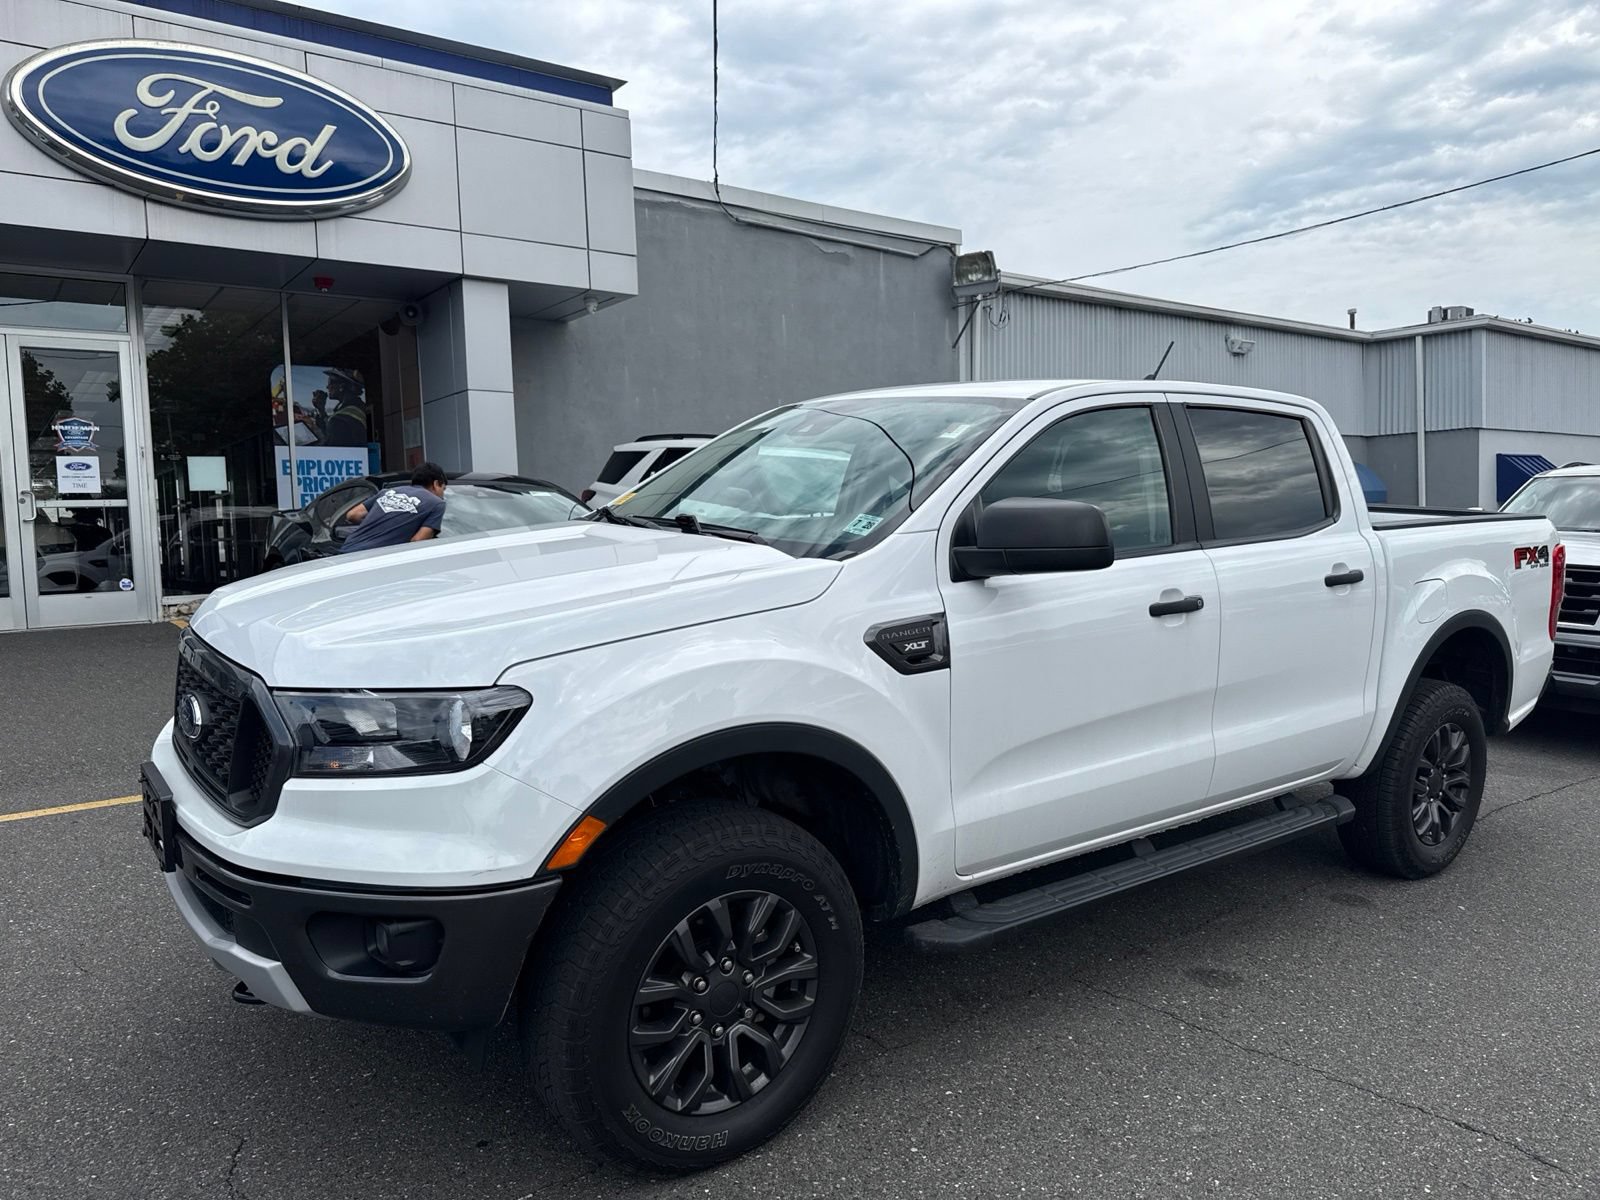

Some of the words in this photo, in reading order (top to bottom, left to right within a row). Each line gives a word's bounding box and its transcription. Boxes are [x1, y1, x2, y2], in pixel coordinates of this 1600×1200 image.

[114, 73, 338, 180] Ford
[282, 459, 363, 476] EMPLOYEE
[1514, 545, 1549, 569] FX4
[881, 626, 931, 640] RANGER
[904, 640, 929, 651] XLT
